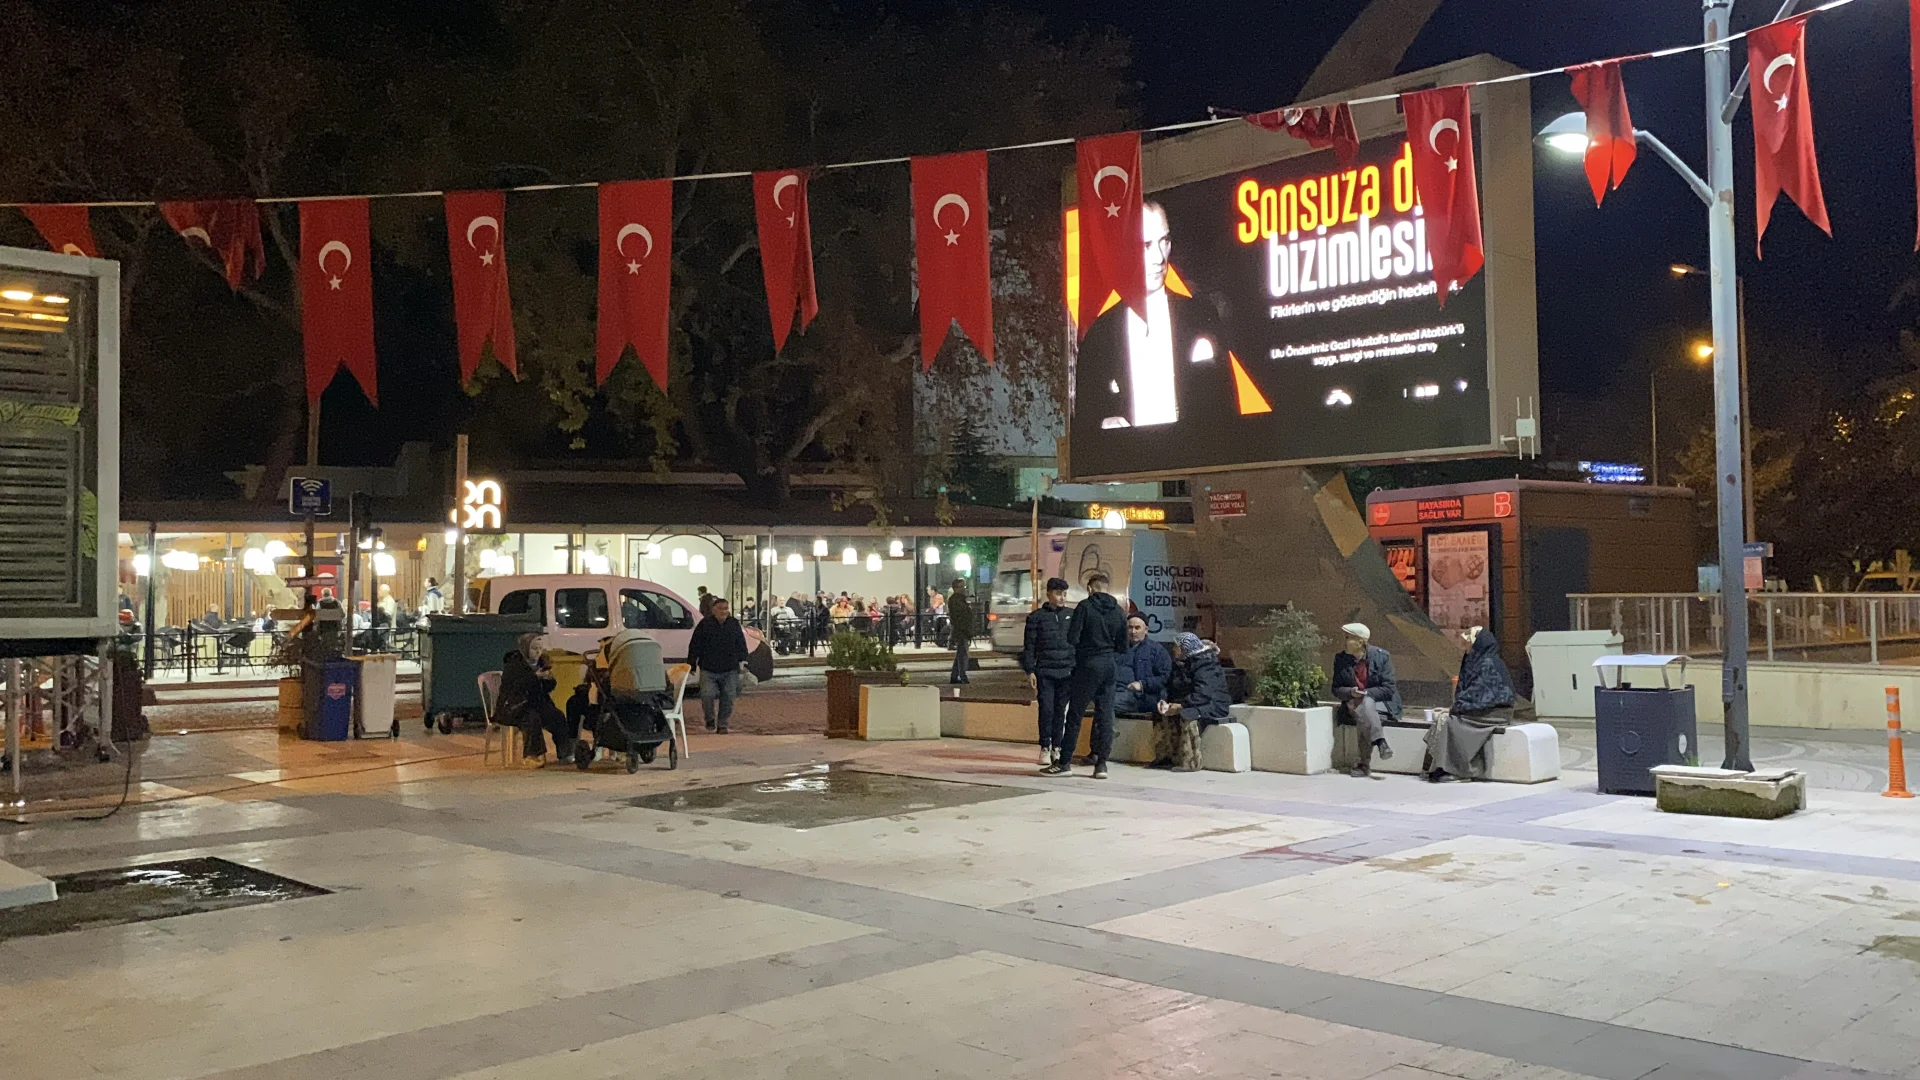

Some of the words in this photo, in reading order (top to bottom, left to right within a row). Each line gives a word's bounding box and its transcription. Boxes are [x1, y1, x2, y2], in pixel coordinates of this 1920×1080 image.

[1237, 165, 1381, 244] Sonsuza
[1268, 203, 1434, 298] bizimlesi
[1270, 301, 1316, 319] Fikirlerin
[1316, 301, 1331, 313] ve
[1331, 288, 1398, 313] gösterdiğin
[1270, 347, 1286, 359] Ulu
[1286, 342, 1330, 357] Önderimiz
[1330, 338, 1351, 352] Gazi
[1351, 335, 1389, 349] Mustafa
[1390, 329, 1420, 344] Kemal
[1339, 350, 1362, 363] sevgi
[1362, 350, 1375, 360] ve
[1375, 344, 1417, 359] minnetle
[1446, 508, 1462, 518] VAR
[1144, 593, 1187, 607] BİZDEN
